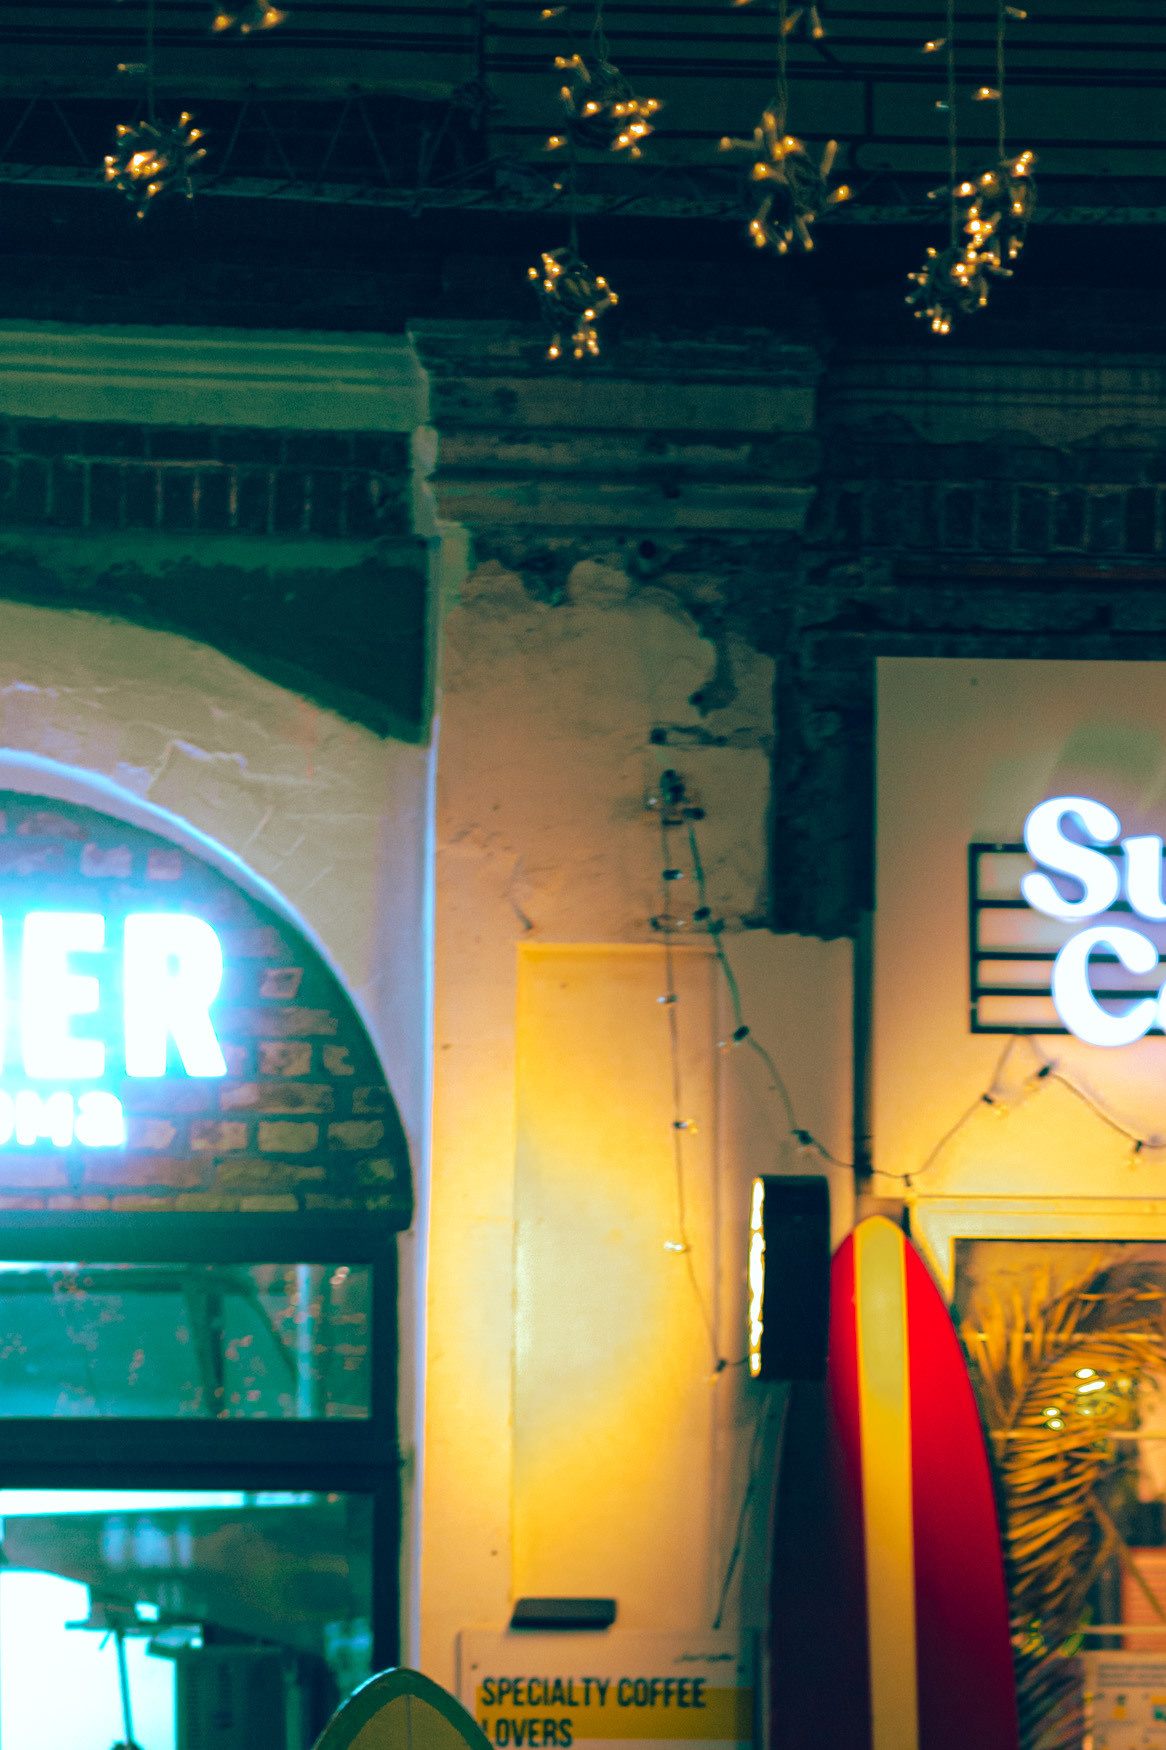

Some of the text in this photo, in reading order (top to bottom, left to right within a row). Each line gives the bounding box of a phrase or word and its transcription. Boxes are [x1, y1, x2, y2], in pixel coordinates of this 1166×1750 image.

[0, 911, 228, 1079] ER
[481, 1677, 707, 1708] SPECIALTY COFFEE
